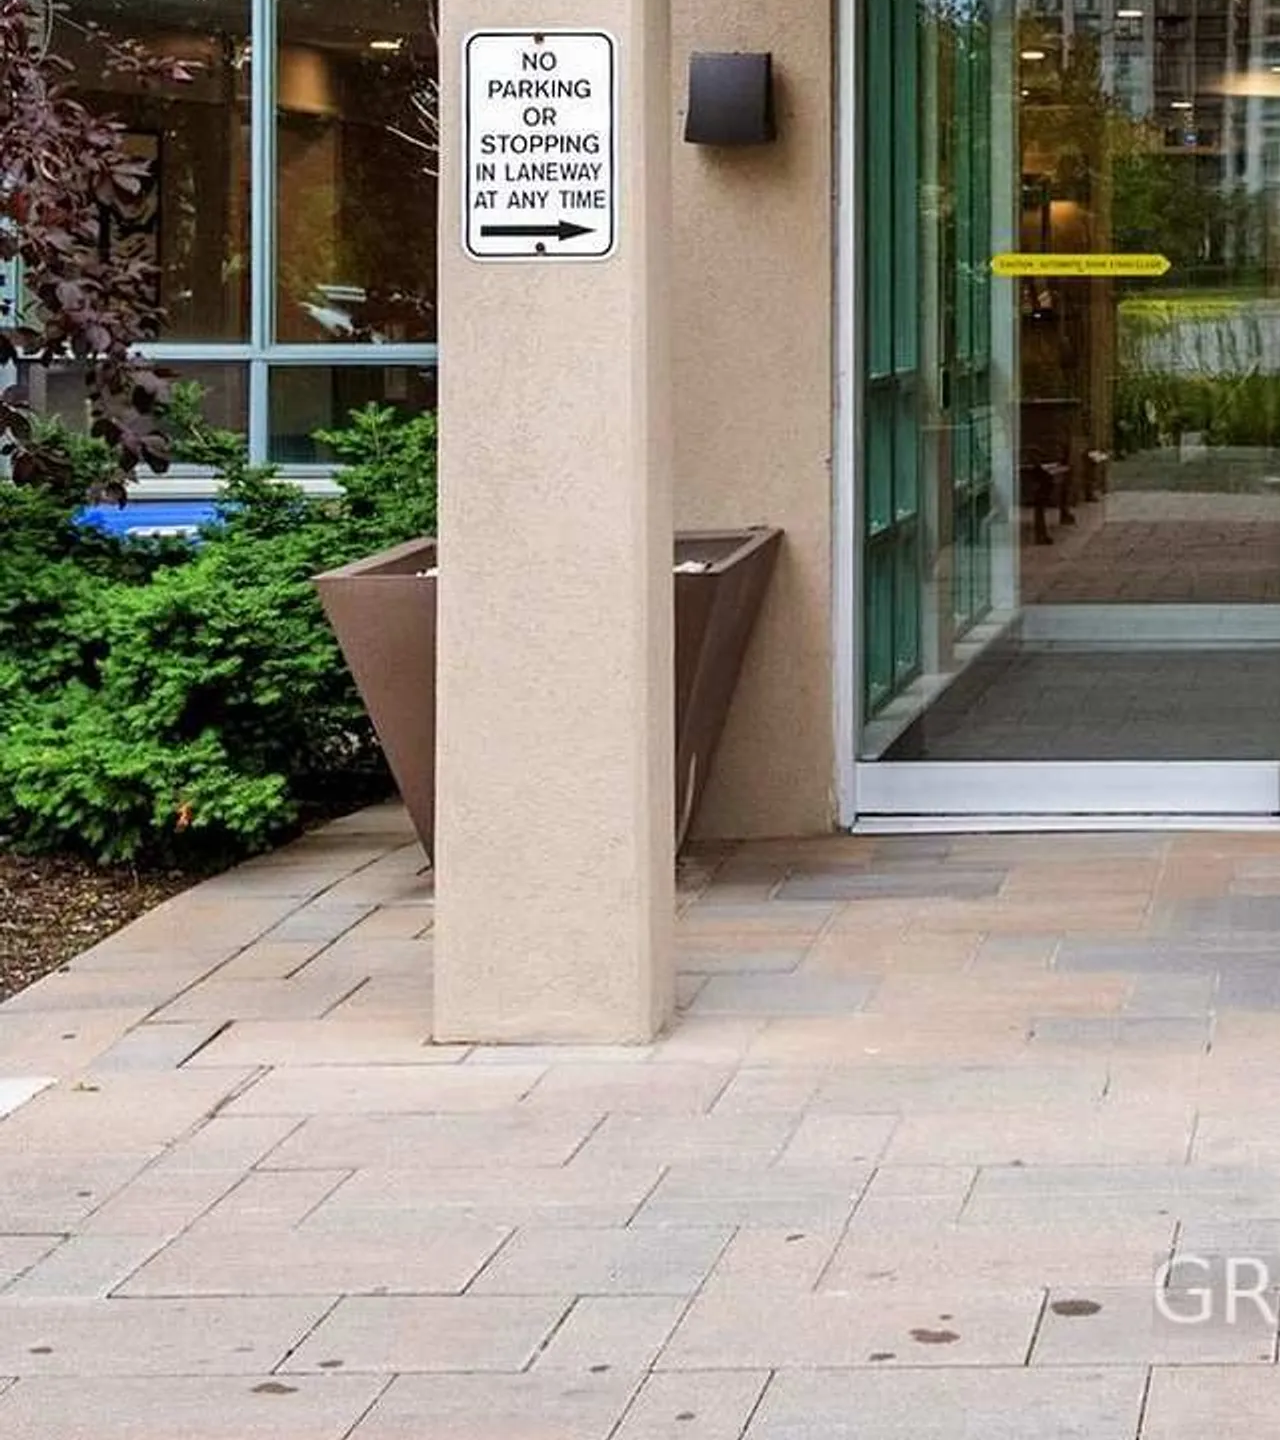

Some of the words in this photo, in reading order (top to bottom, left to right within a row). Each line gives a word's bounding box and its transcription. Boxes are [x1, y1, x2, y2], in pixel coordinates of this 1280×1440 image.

[522, 52, 557, 71] NO
[488, 79, 591, 98] PARKING
[523, 107, 556, 126] OR
[480, 134, 600, 154] STOPPING
[476, 163, 495, 181] IN
[505, 163, 602, 182] LANEWAY
[474, 190, 498, 209] AT
[507, 190, 549, 209] ANY
[559, 190, 606, 209] TIME
